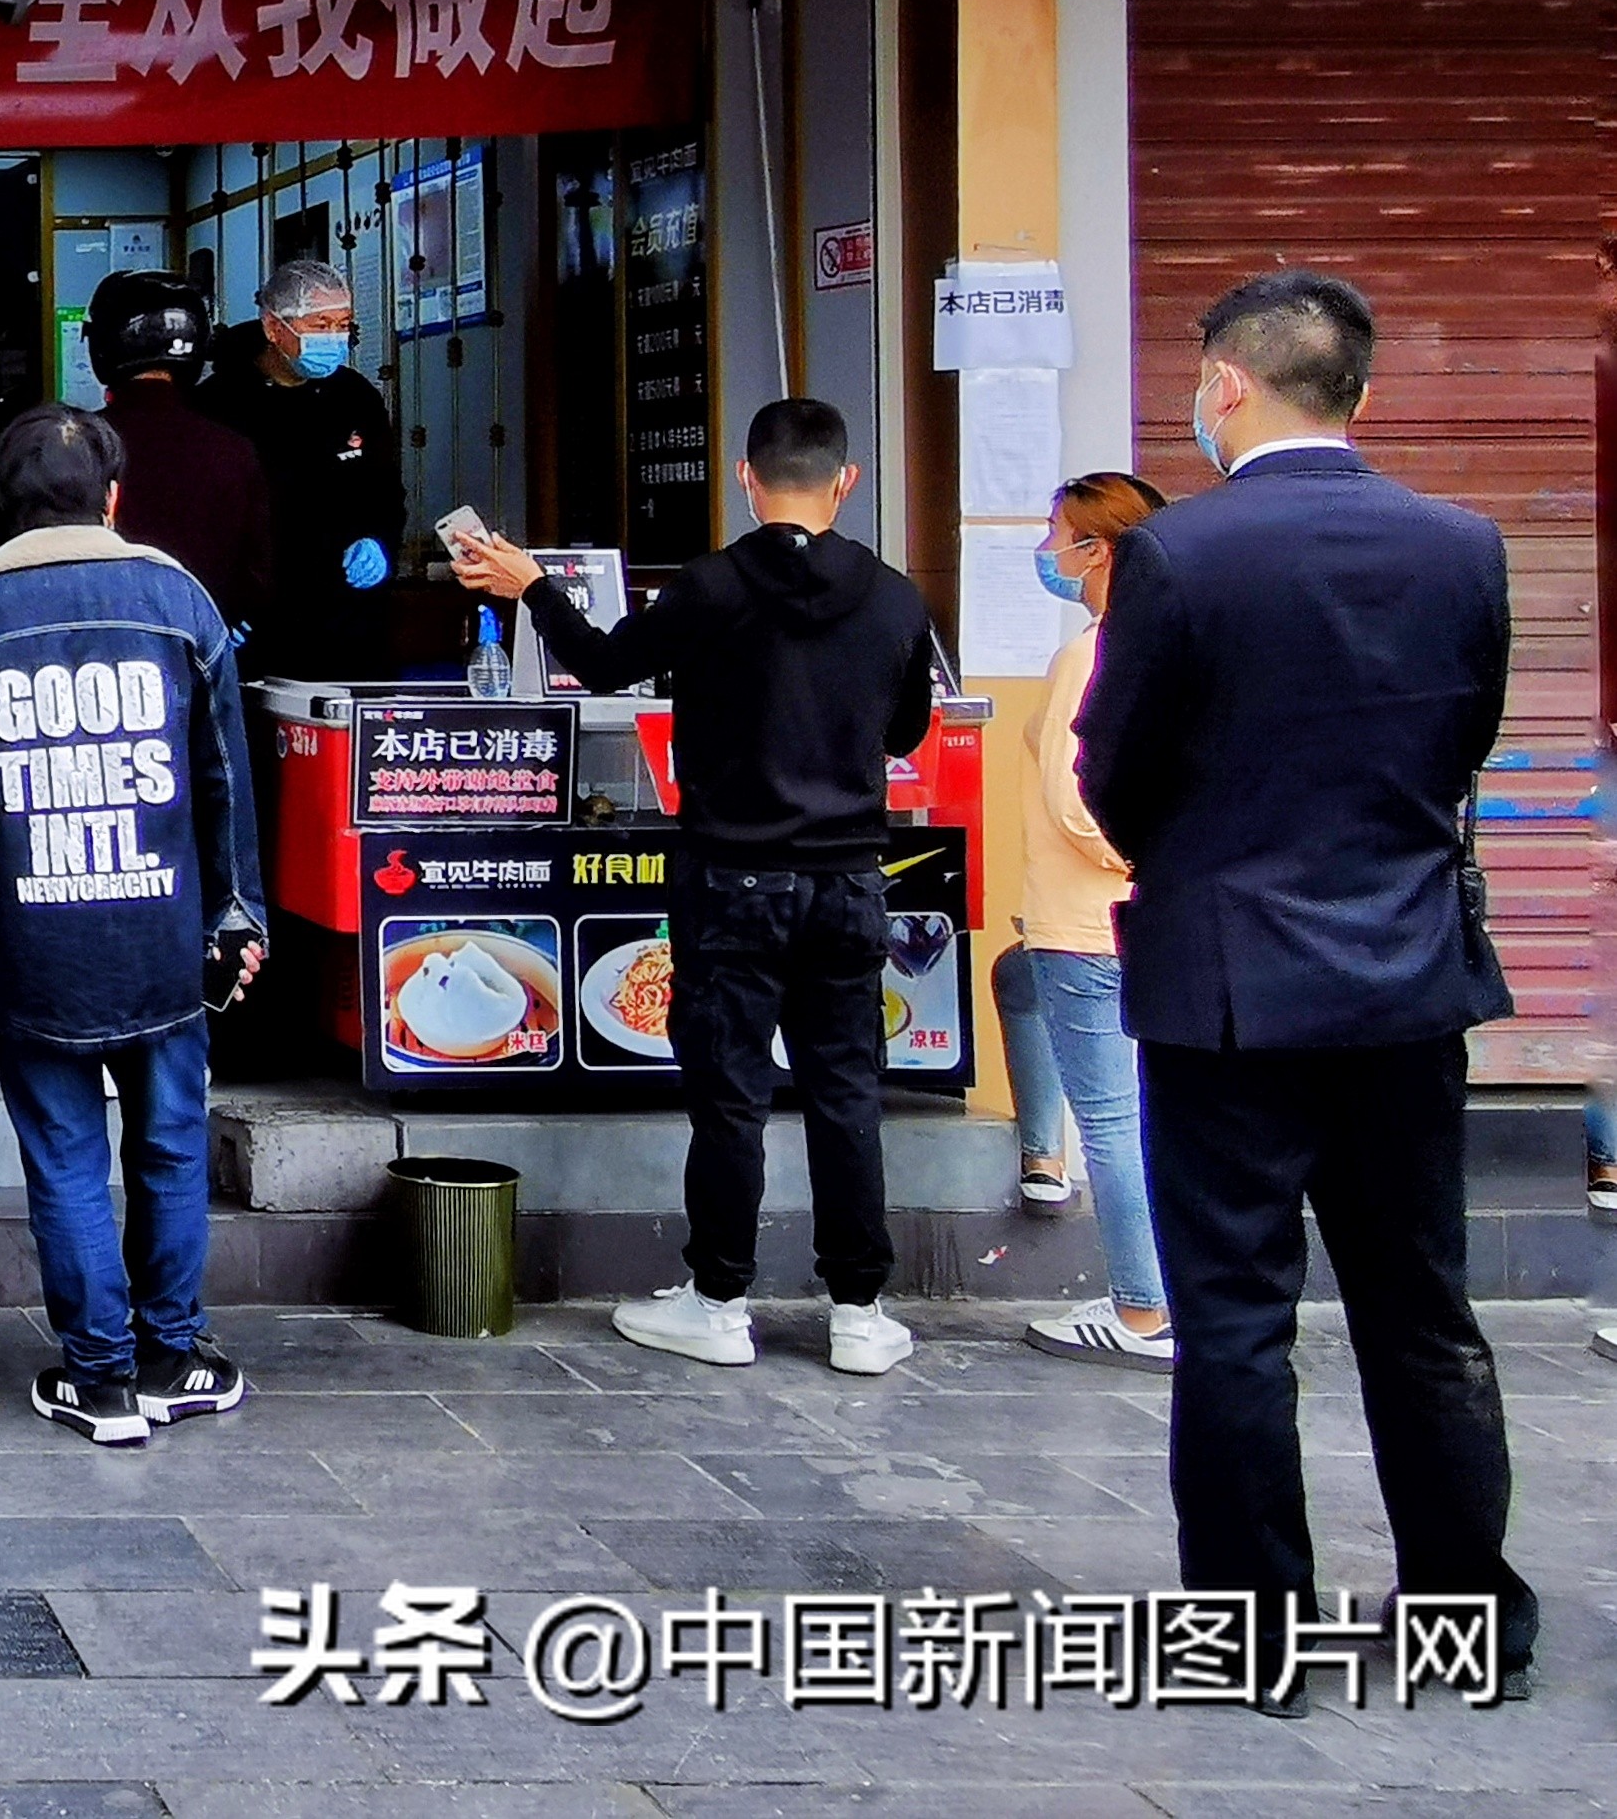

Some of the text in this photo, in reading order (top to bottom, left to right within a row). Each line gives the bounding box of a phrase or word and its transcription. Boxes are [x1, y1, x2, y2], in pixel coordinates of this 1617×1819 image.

[938, 289, 1066, 316] 本店已消毒
[371, 728, 558, 763] 本店已消毒
[28, 808, 161, 877] INTL.
[418, 859, 553, 883] 宜见牛肉面
